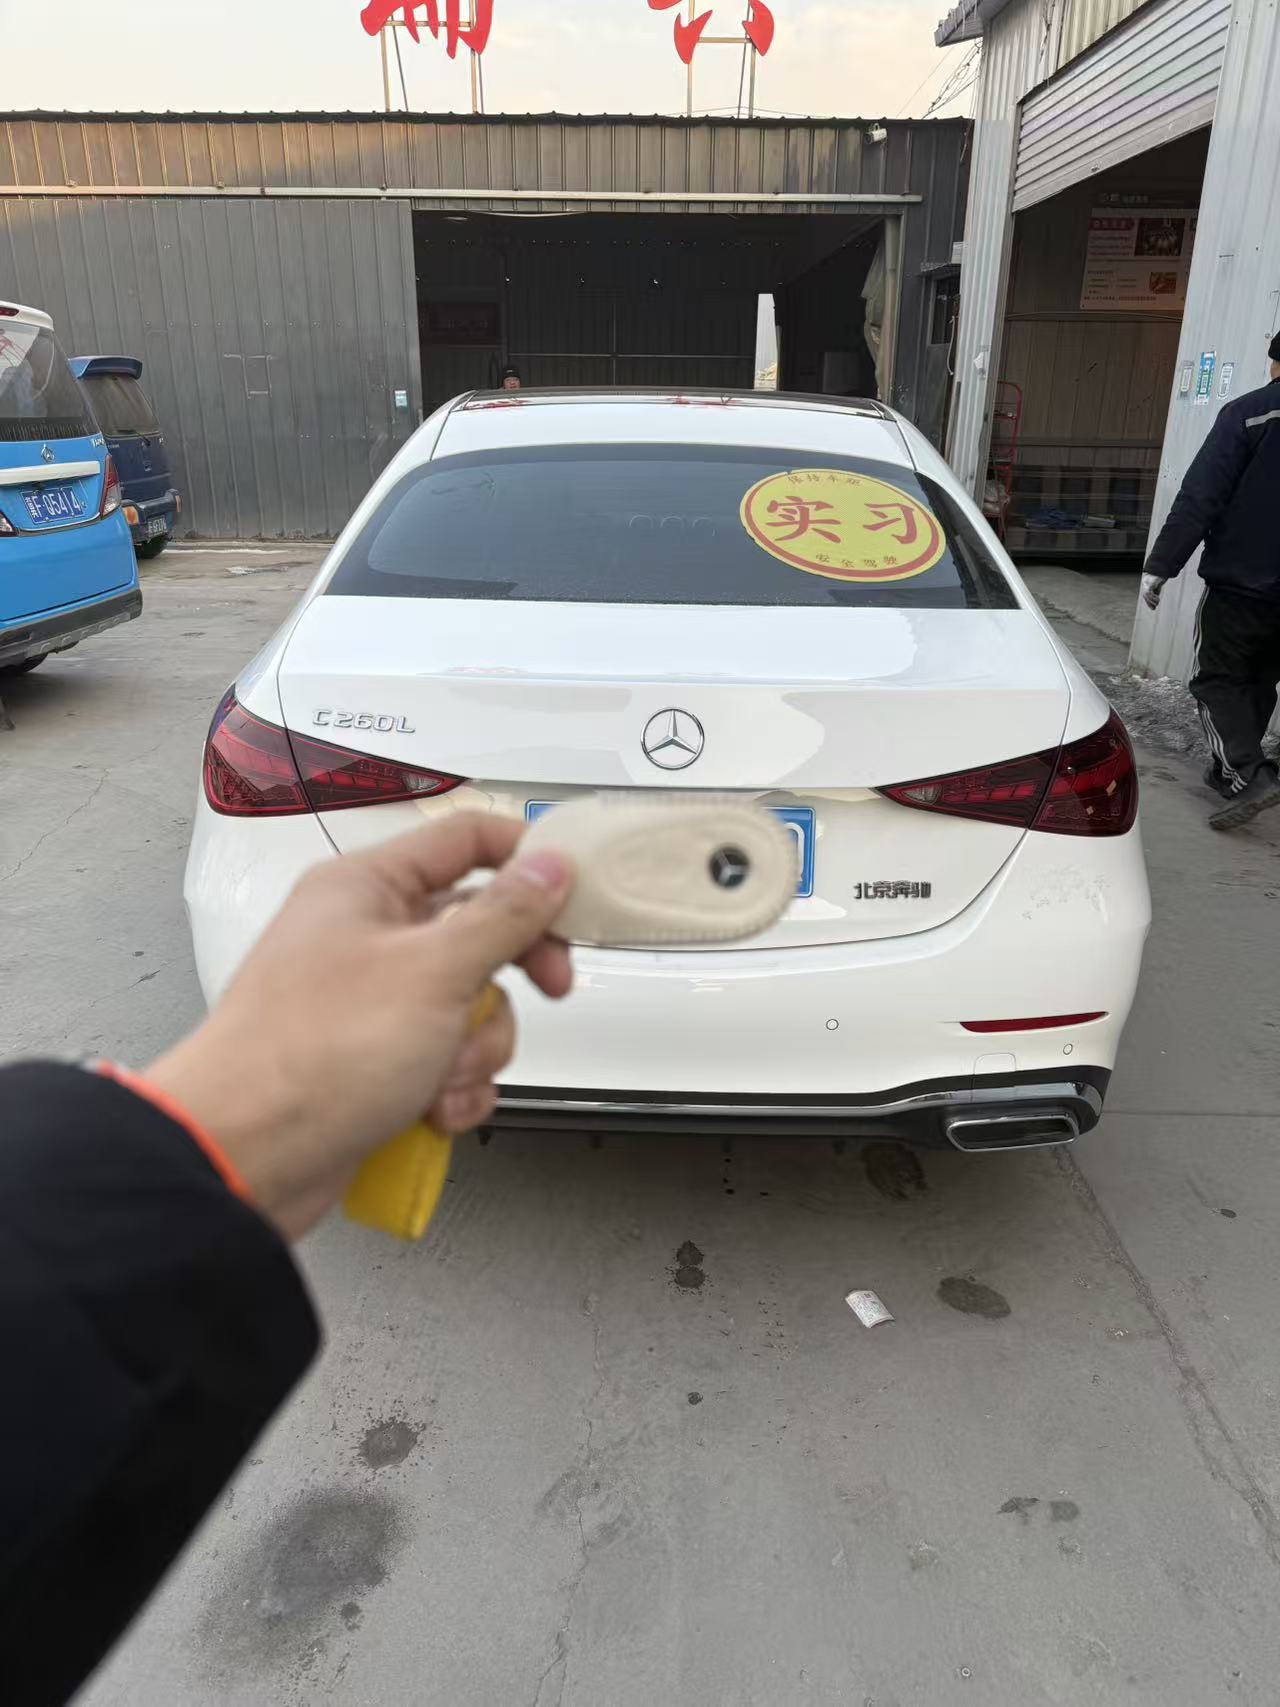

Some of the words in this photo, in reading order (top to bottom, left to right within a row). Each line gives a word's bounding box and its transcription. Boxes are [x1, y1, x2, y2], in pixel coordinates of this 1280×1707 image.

[765, 495, 918, 545] 实习
[853, 880, 932, 900] 北京奔驰
